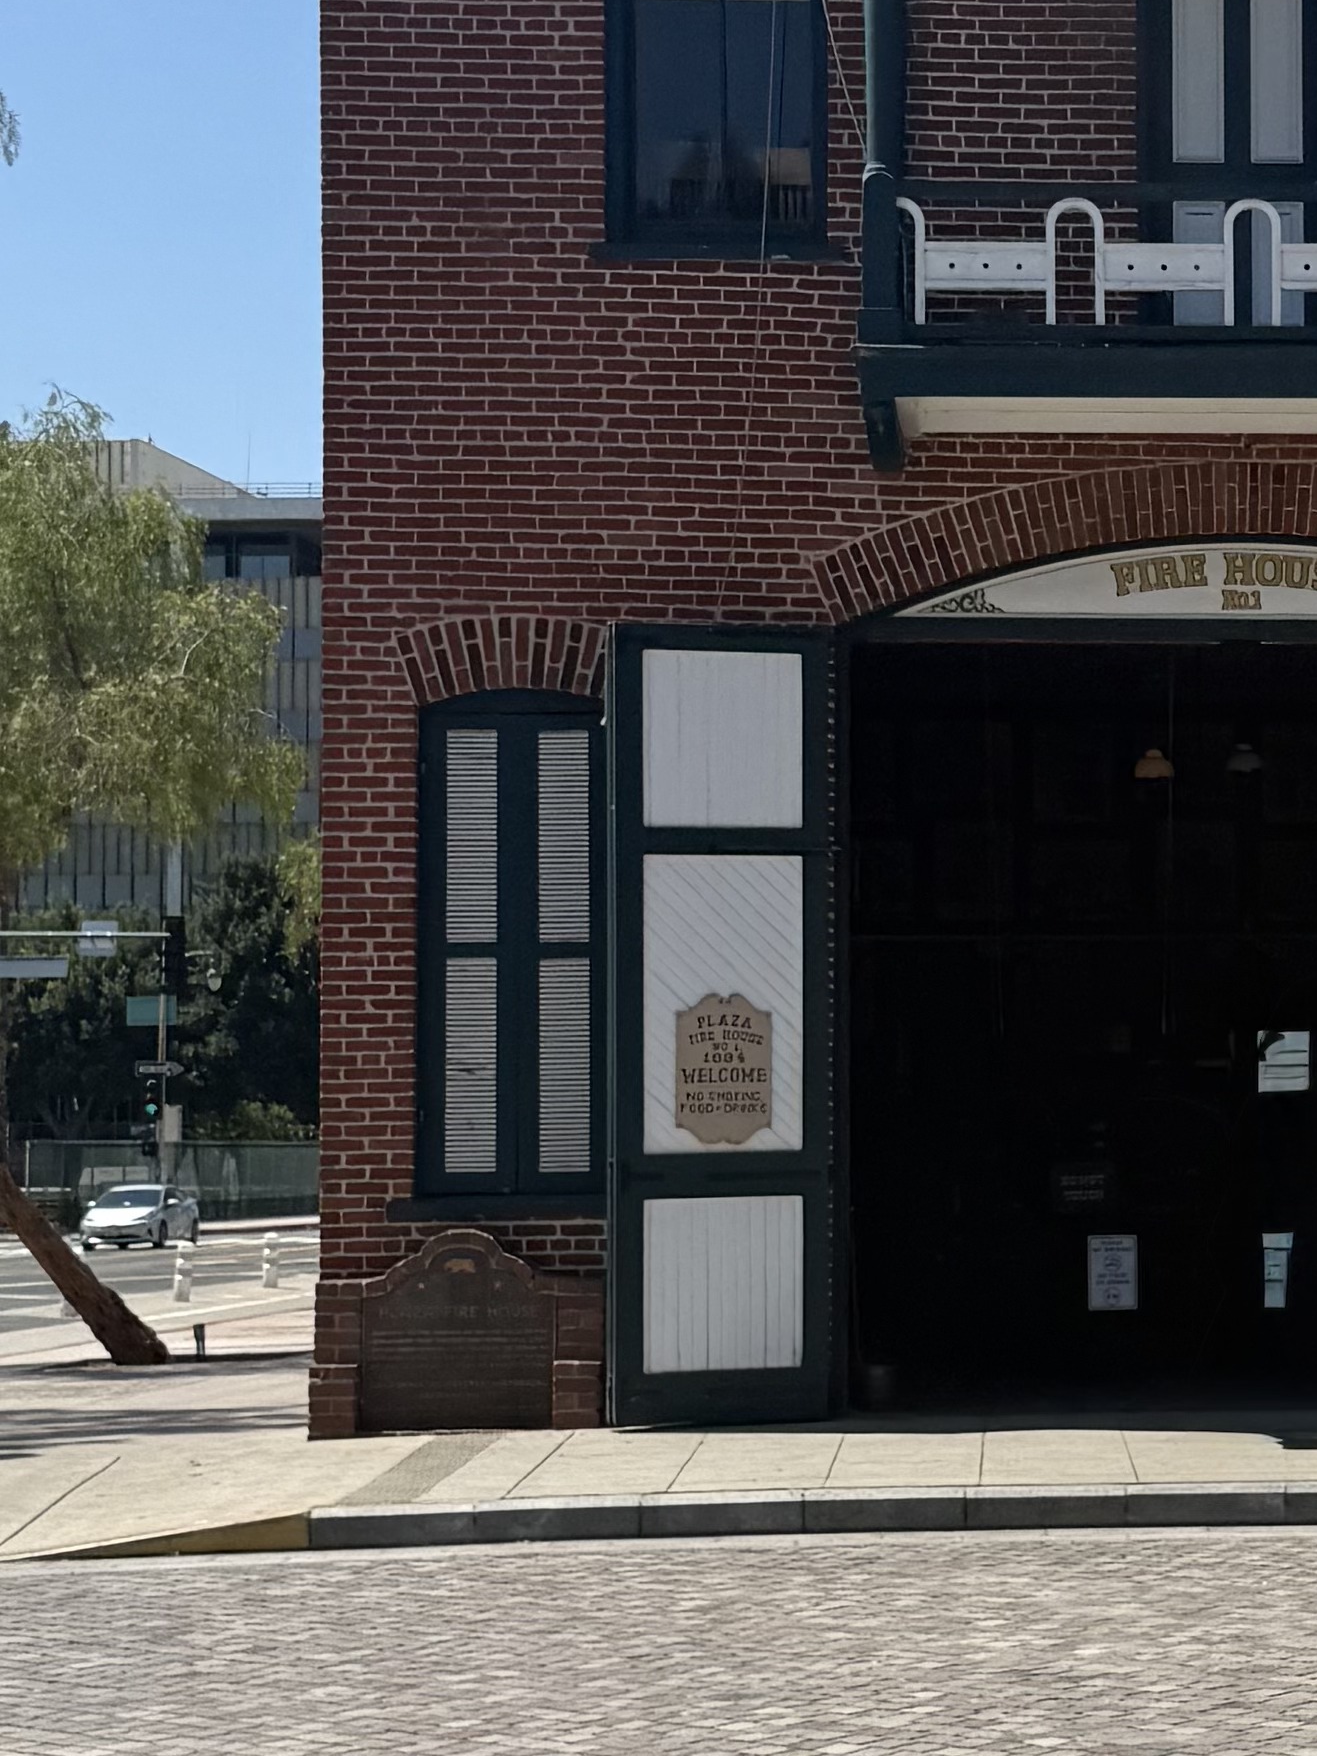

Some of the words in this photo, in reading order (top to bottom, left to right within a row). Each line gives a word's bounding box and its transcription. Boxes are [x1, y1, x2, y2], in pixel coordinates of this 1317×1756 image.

[1110, 553, 1209, 597] FIRE
[697, 1014, 752, 1029] PLAZA
[689, 1031, 716, 1045] FIRE
[723, 1030, 764, 1045] HOUSE
[681, 1068, 767, 1084] WELCOME
[686, 1091, 704, 1101] NO
[680, 1104, 714, 1114] FOOD
[444, 1305, 480, 1318] FIRE
